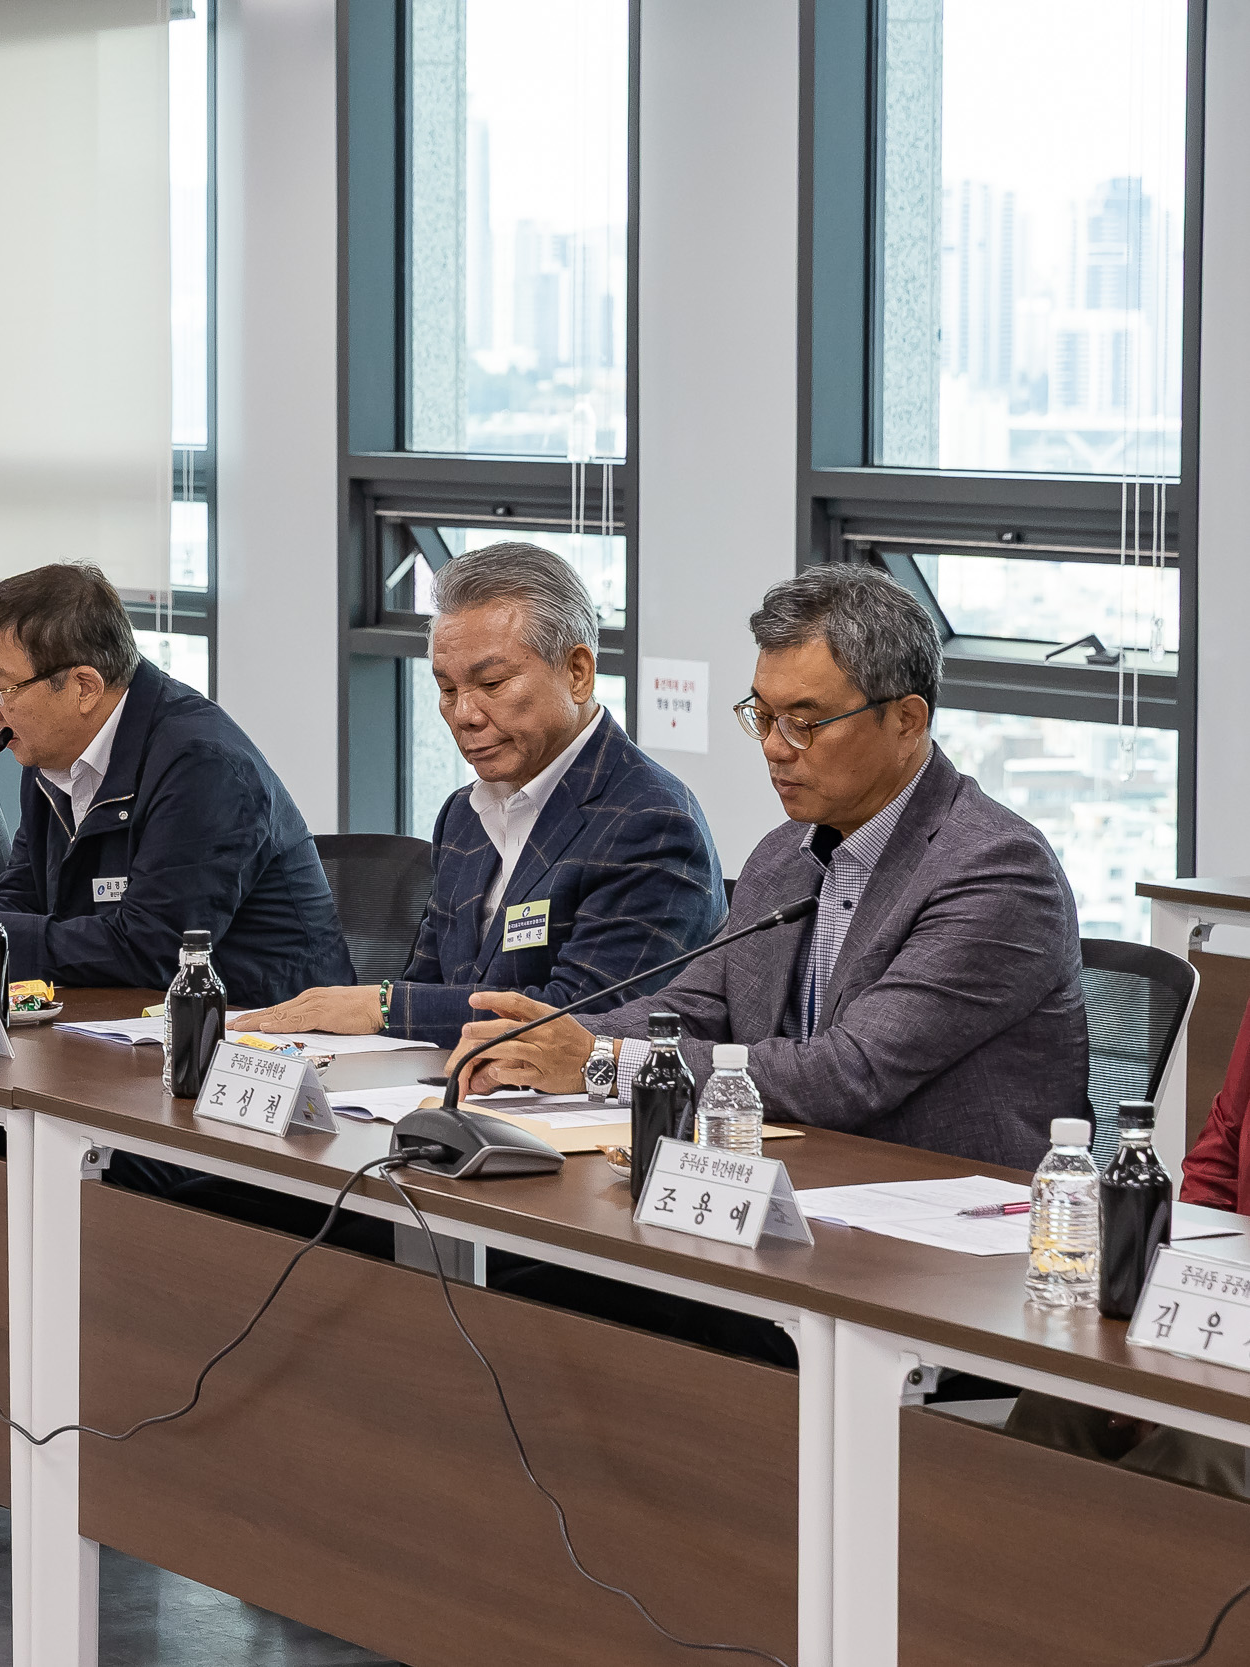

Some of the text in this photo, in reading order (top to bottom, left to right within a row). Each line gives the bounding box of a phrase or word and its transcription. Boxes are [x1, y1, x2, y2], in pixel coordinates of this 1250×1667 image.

[230, 1053, 287, 1081] 중곡3동 공공위원장
[209, 1083, 282, 1124] 조성철
[679, 1152, 754, 1184] 중곡4동 민간위원장
[654, 1186, 752, 1236] 조용예
